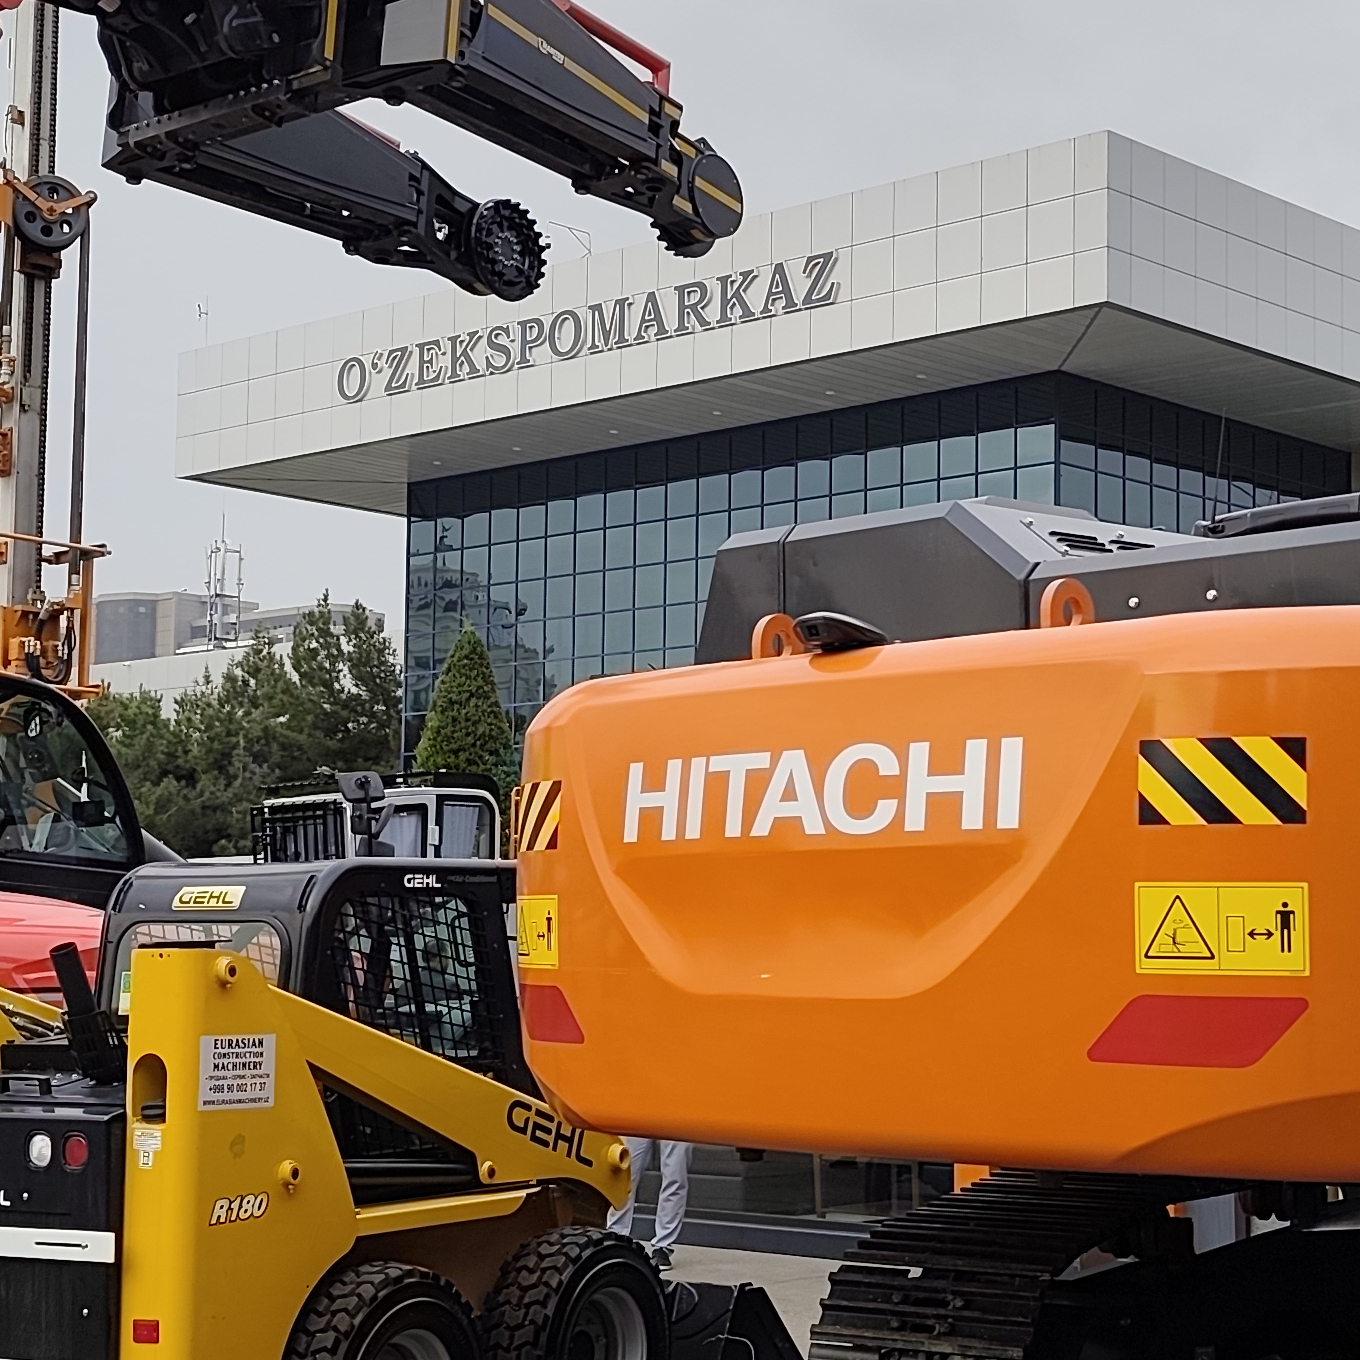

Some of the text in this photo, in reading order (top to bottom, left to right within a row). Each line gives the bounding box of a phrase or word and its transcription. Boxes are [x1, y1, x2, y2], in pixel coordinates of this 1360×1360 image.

[623, 736, 1024, 844] HITACHI
[403, 873, 442, 888] GEHL
[178, 890, 234, 905] GEHL
[213, 1037, 264, 1050] EURASIAN
[212, 1050, 265, 1060] CONSTRUCTION
[212, 1060, 264, 1072] MACHINERY
[208, 1081, 267, 1094] +998 90 002 17 37
[506, 1099, 594, 1168] GEHL
[208, 1191, 270, 1227] R180
